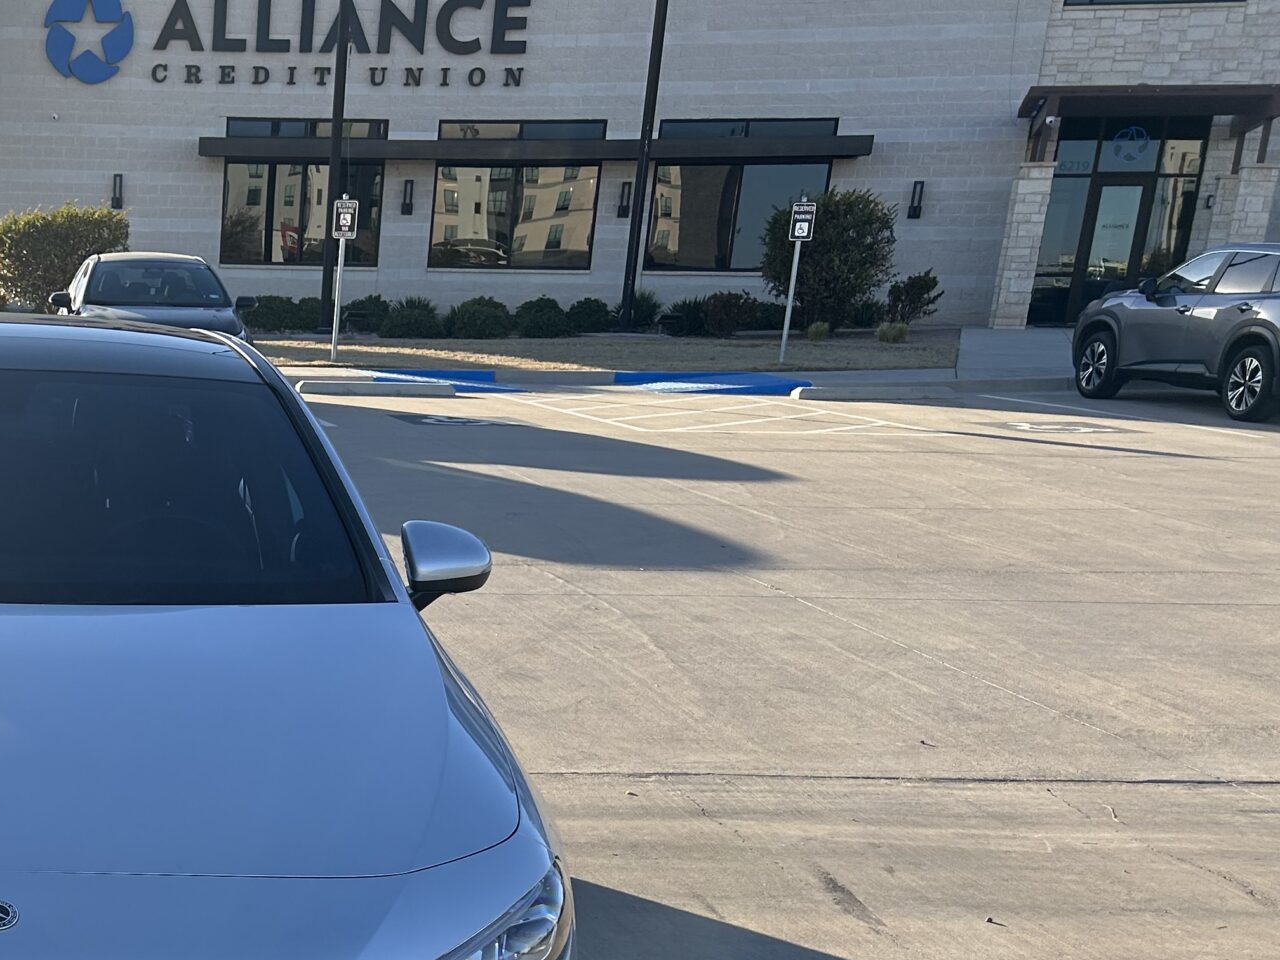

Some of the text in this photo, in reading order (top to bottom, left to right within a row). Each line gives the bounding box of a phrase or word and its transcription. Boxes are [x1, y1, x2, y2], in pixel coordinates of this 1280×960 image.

[152, 0, 531, 55] ALLIANCE
[151, 64, 524, 88] CREDIT UNION
